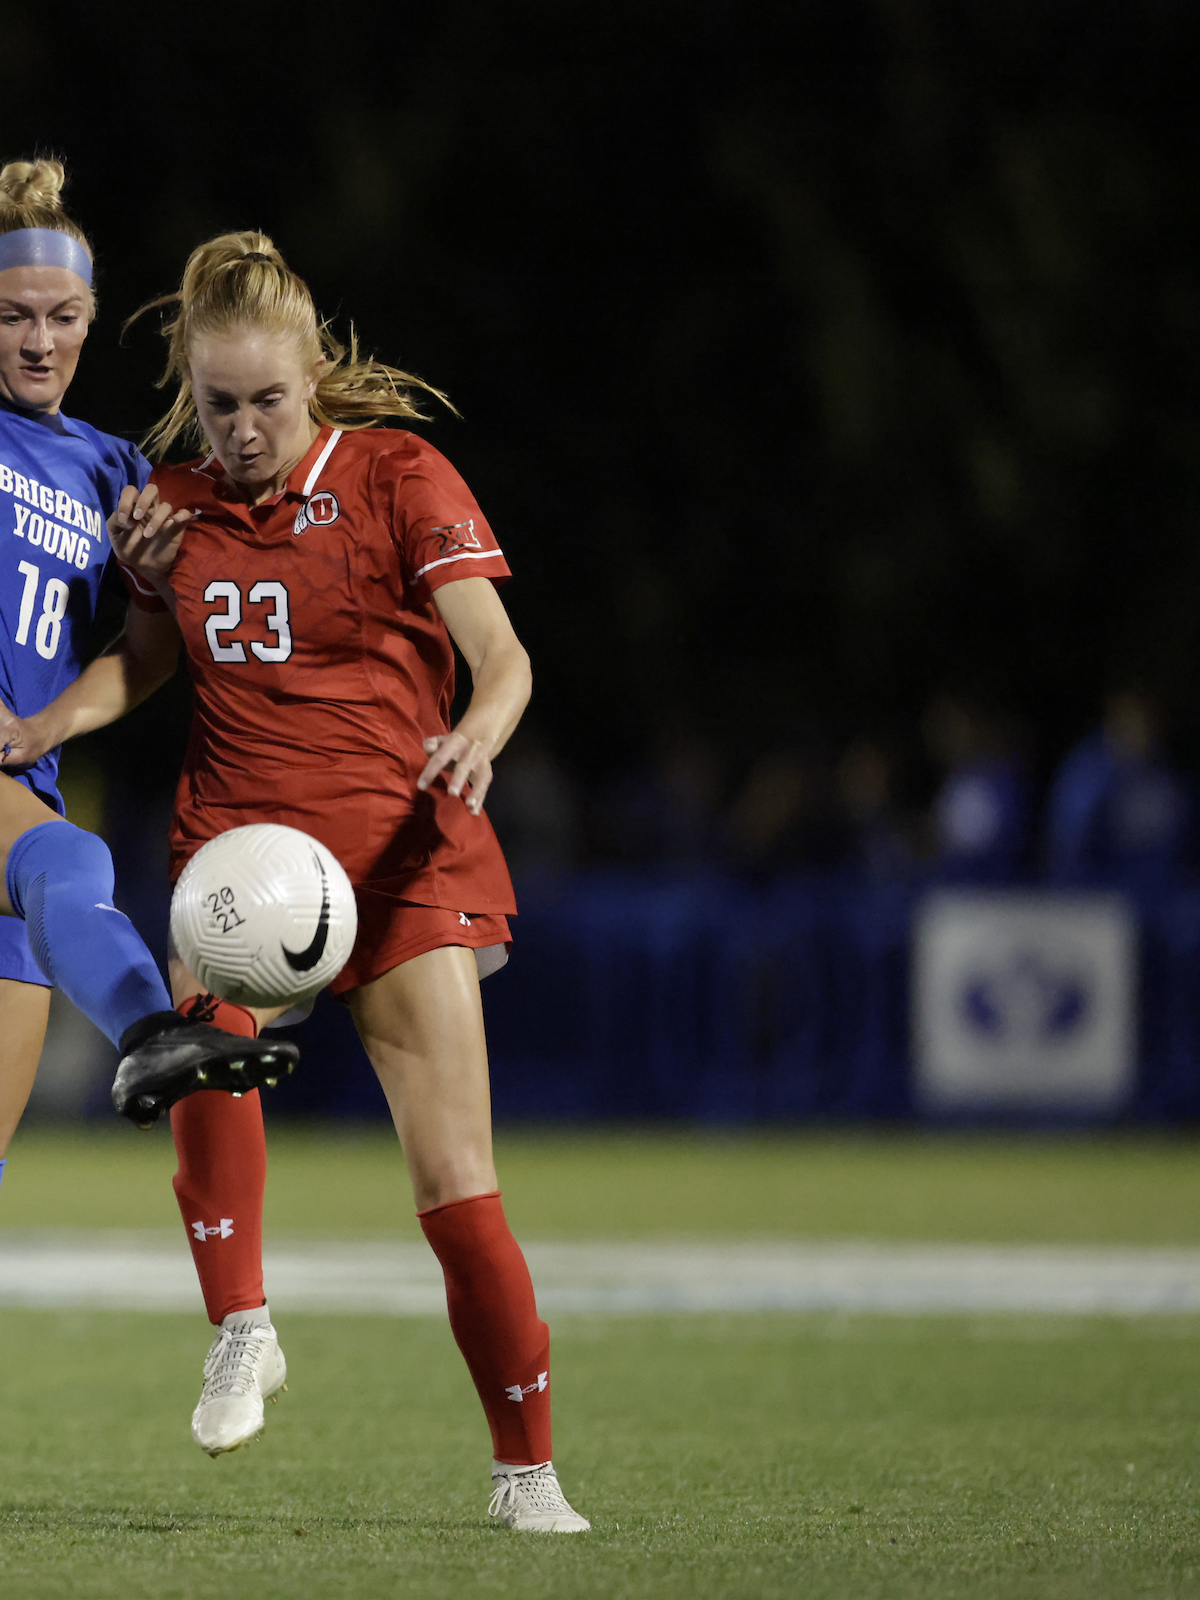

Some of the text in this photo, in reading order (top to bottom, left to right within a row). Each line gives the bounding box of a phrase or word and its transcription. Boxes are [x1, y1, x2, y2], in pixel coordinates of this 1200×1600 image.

[310, 497, 333, 522] U
[13, 503, 91, 570] YOUNG
[15, 560, 70, 660] 18
[203, 579, 293, 664] 23
[208, 887, 234, 913] 20
[216, 907, 246, 933] 21
